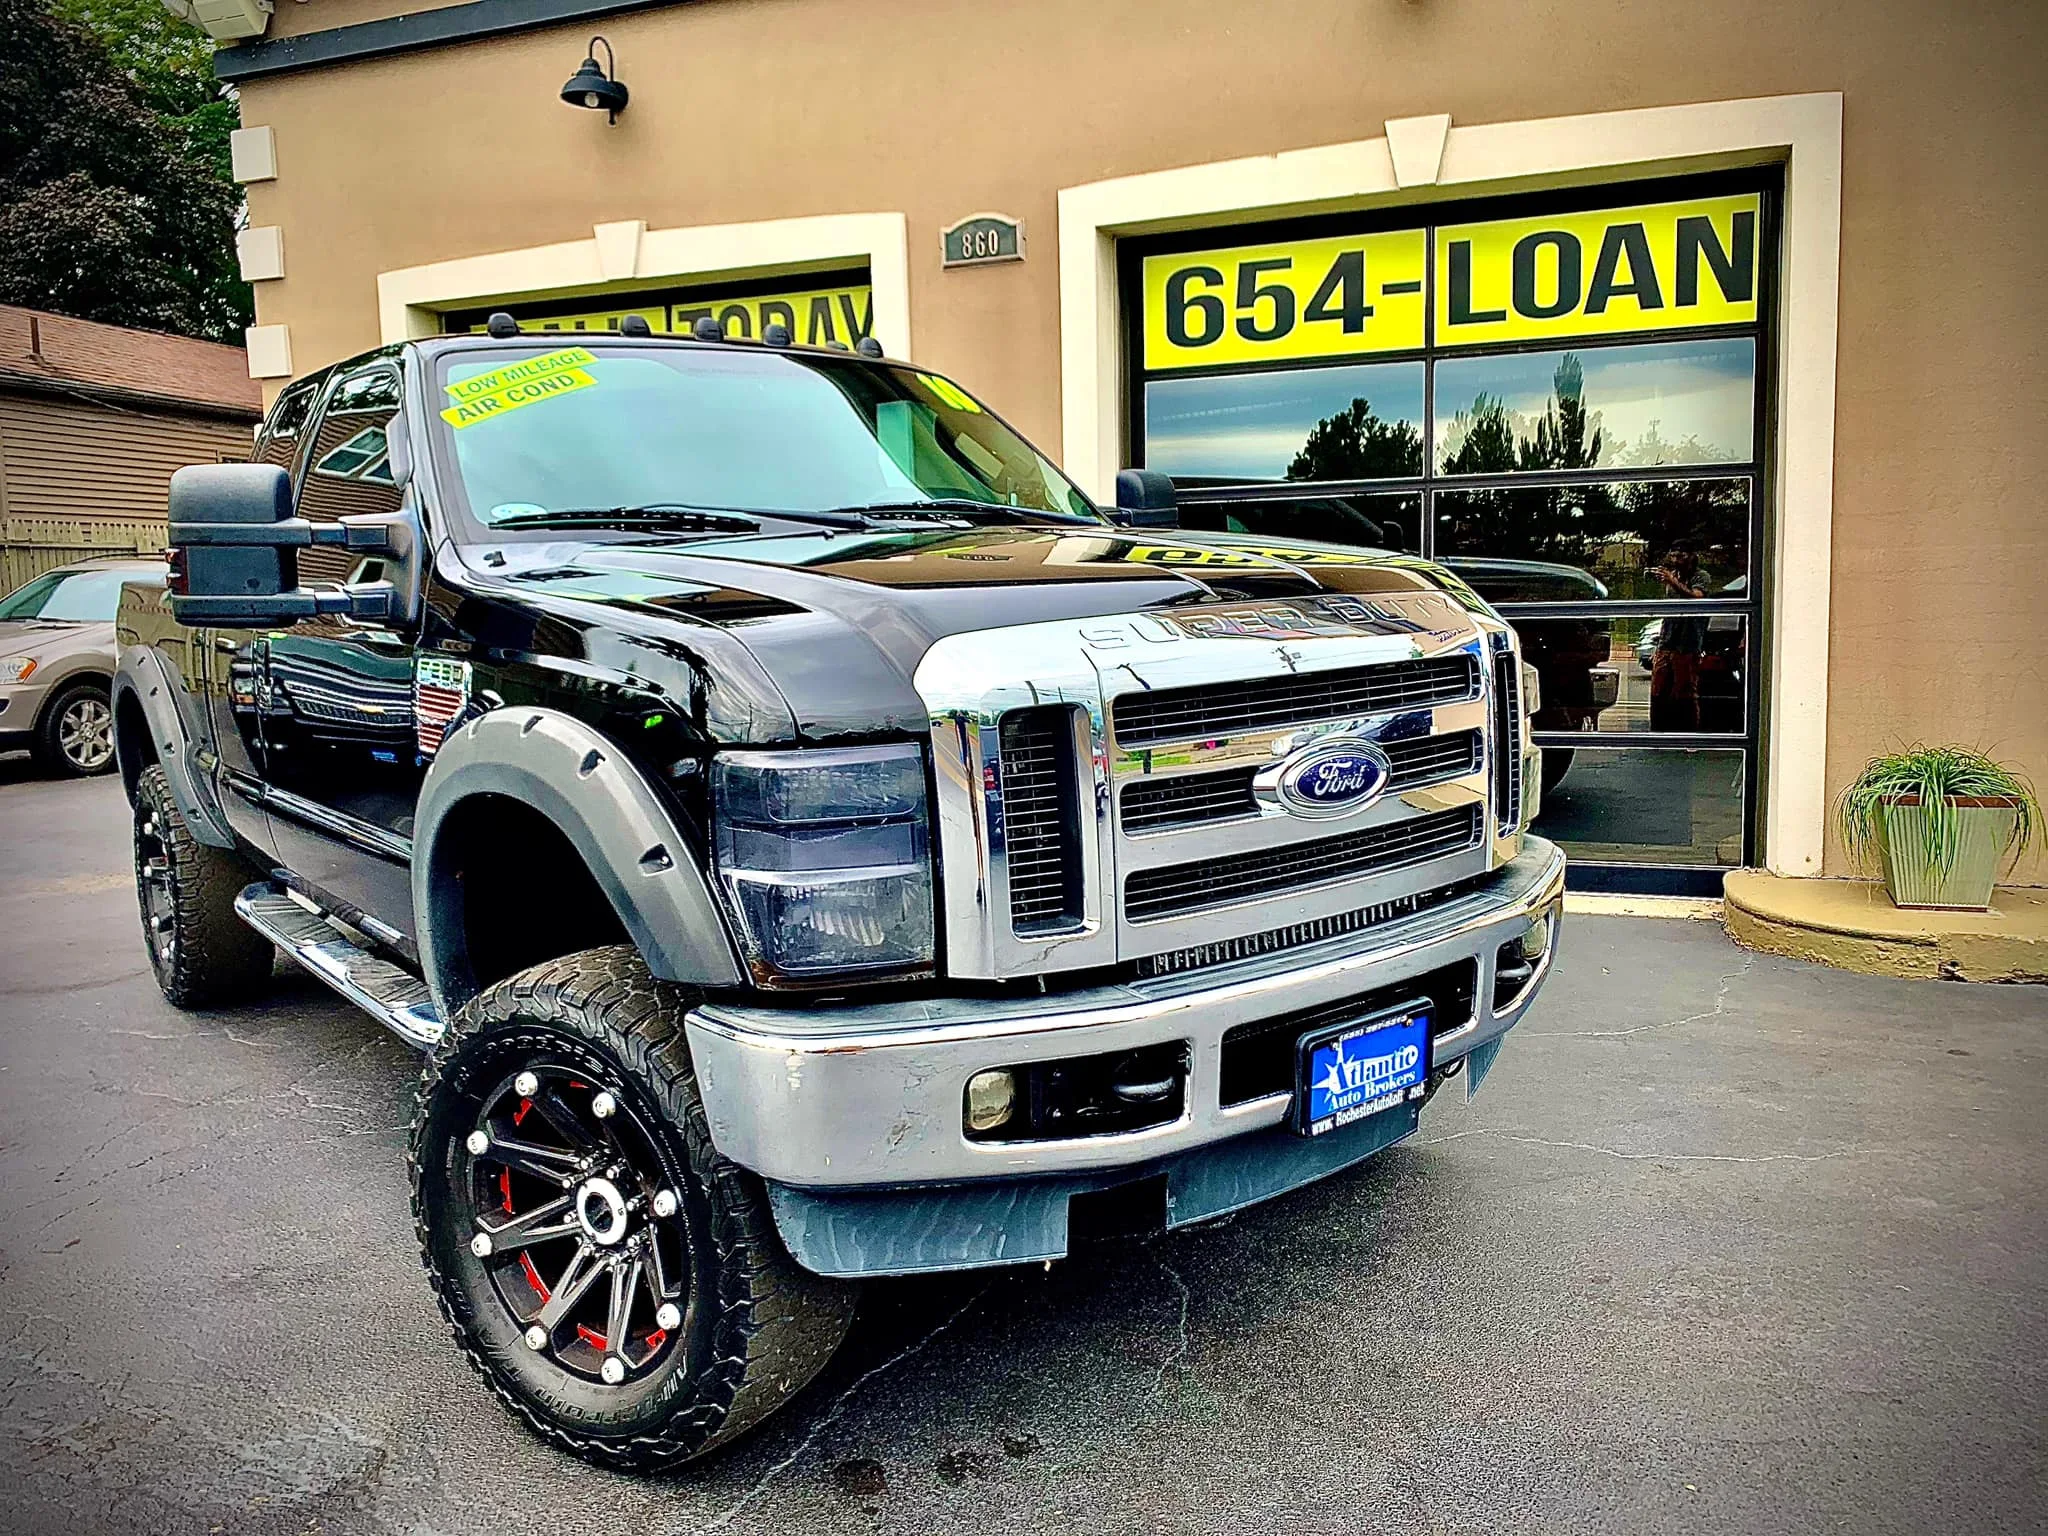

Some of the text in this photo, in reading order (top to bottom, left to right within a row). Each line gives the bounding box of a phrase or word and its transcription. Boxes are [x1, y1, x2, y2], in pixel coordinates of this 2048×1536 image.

[962, 229, 998, 258] 860
[1165, 210, 1755, 348] 654-LOAN
[454, 350, 587, 399] LOW MILEAGE
[457, 373, 576, 422] AIR COND
[1079, 597, 1457, 650] SUPER DUTY
[1314, 760, 1366, 796] Ford
[1328, 1070, 1416, 1112] Auto Brokers
